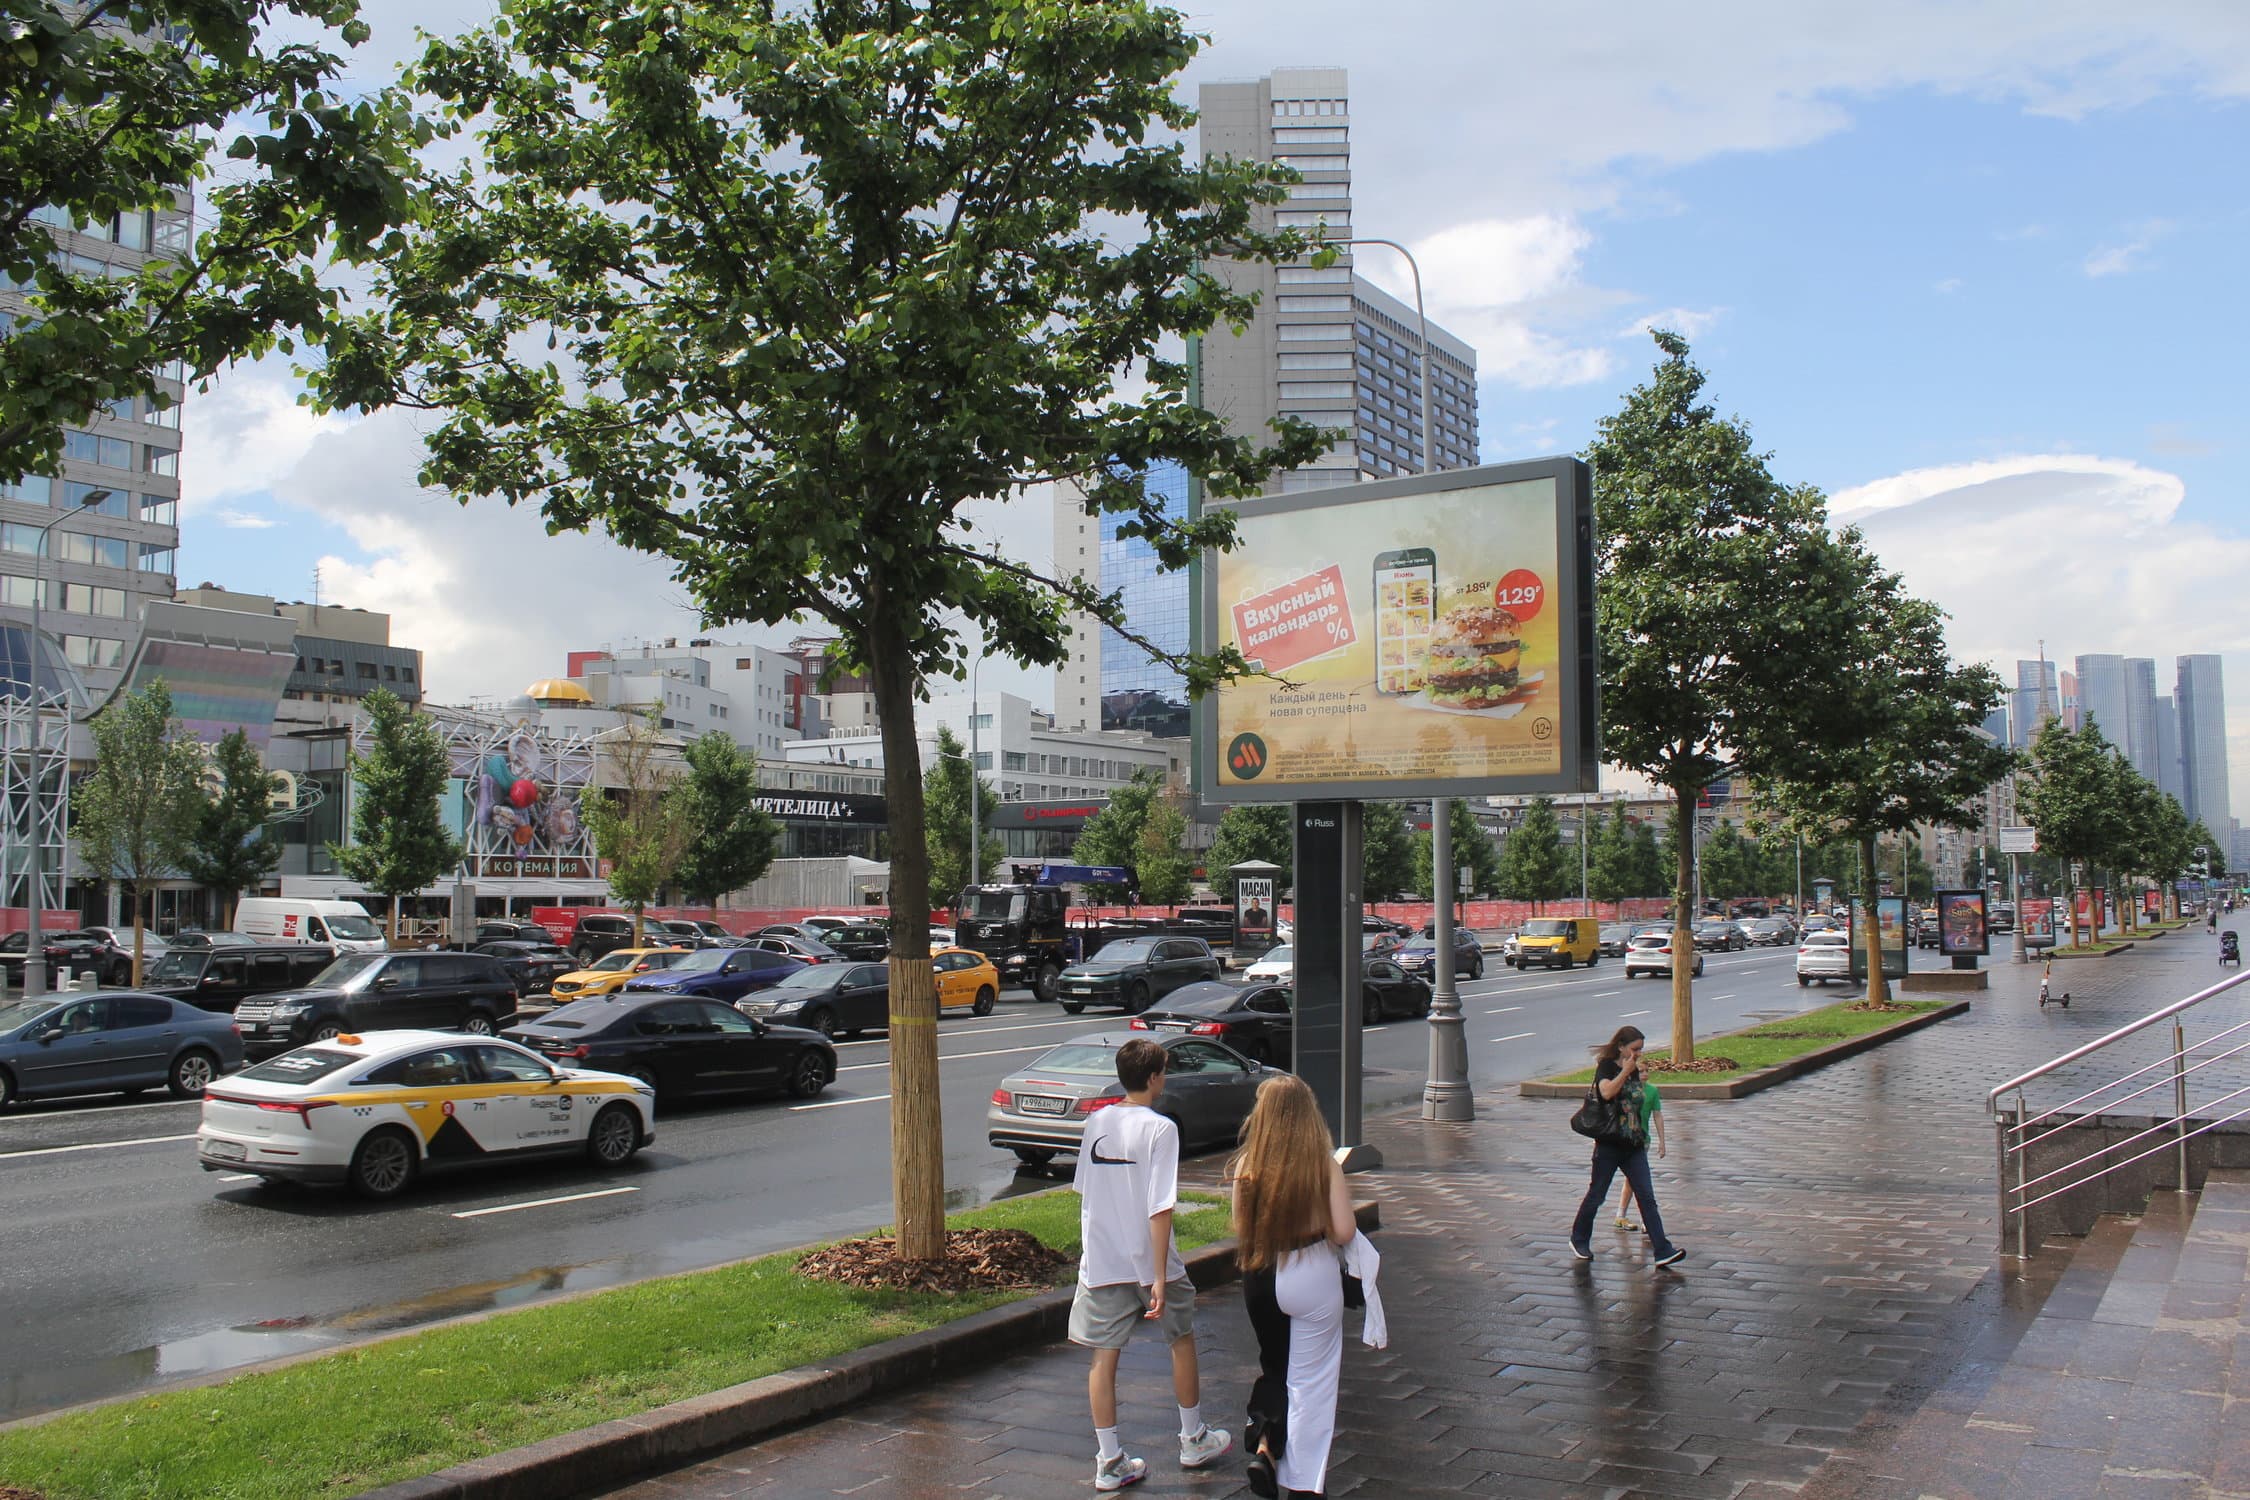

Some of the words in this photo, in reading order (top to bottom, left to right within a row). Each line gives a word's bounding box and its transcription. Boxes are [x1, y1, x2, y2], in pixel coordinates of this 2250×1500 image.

[1243, 577, 1335, 629] Вкусный
[1247, 603, 1339, 647] календарь
[1270, 691, 1316, 705] Каждый
[1319, 691, 1346, 702] день
[1270, 707, 1303, 718] новая
[1305, 703, 1367, 718] суперцена
[1535, 723, 1550, 735] 12+
[749, 797, 841, 820] МЕТЕЛИЦА
[1314, 818, 1335, 828] Russ
[1241, 882, 1271, 897] MACAN
